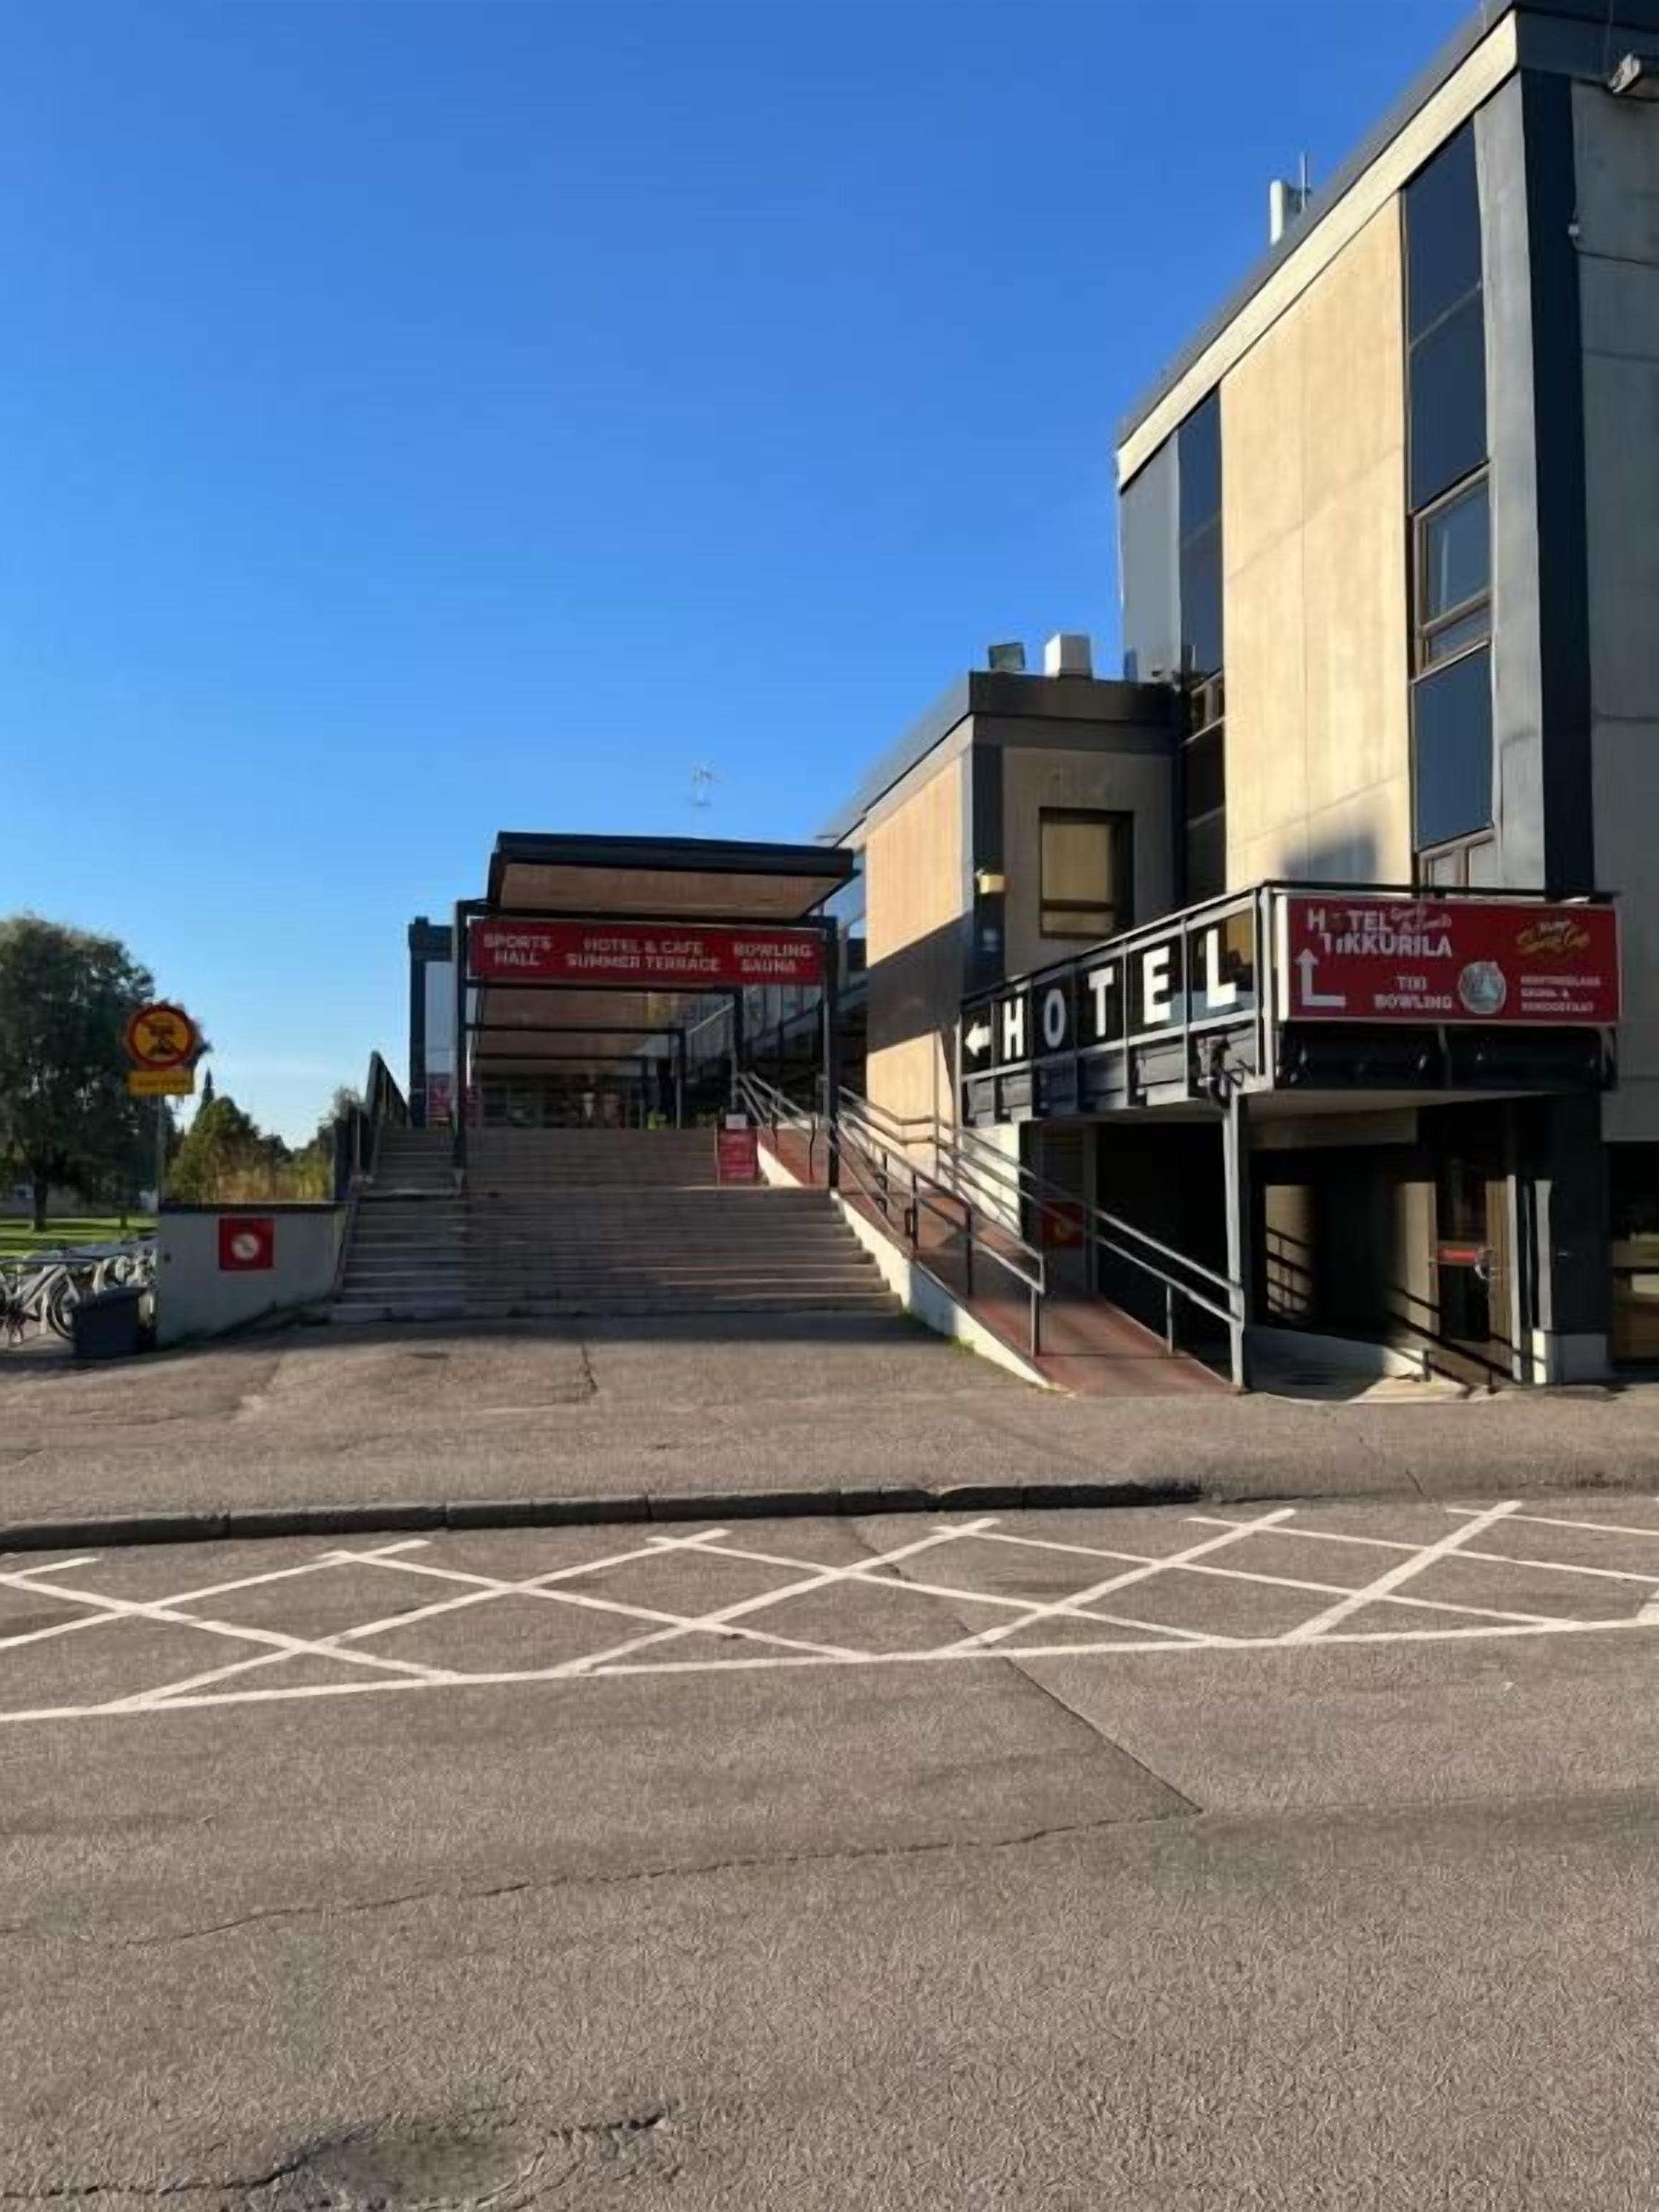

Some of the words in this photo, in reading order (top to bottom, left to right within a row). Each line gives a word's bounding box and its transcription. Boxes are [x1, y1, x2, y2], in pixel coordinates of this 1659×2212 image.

[1307, 907, 1393, 932] HTEL
[483, 934, 552, 950] SPORTS
[584, 938, 642, 953] HOTEL
[1318, 932, 1452, 958] TIKKURILA
[495, 950, 541, 966] HALL
[733, 943, 814, 958] BOWLING
[566, 953, 640, 968] SUMMER
[646, 956, 720, 971] TERRACE
[741, 959, 797, 974] SAUNA
[1004, 929, 1236, 1061] HOTEL
